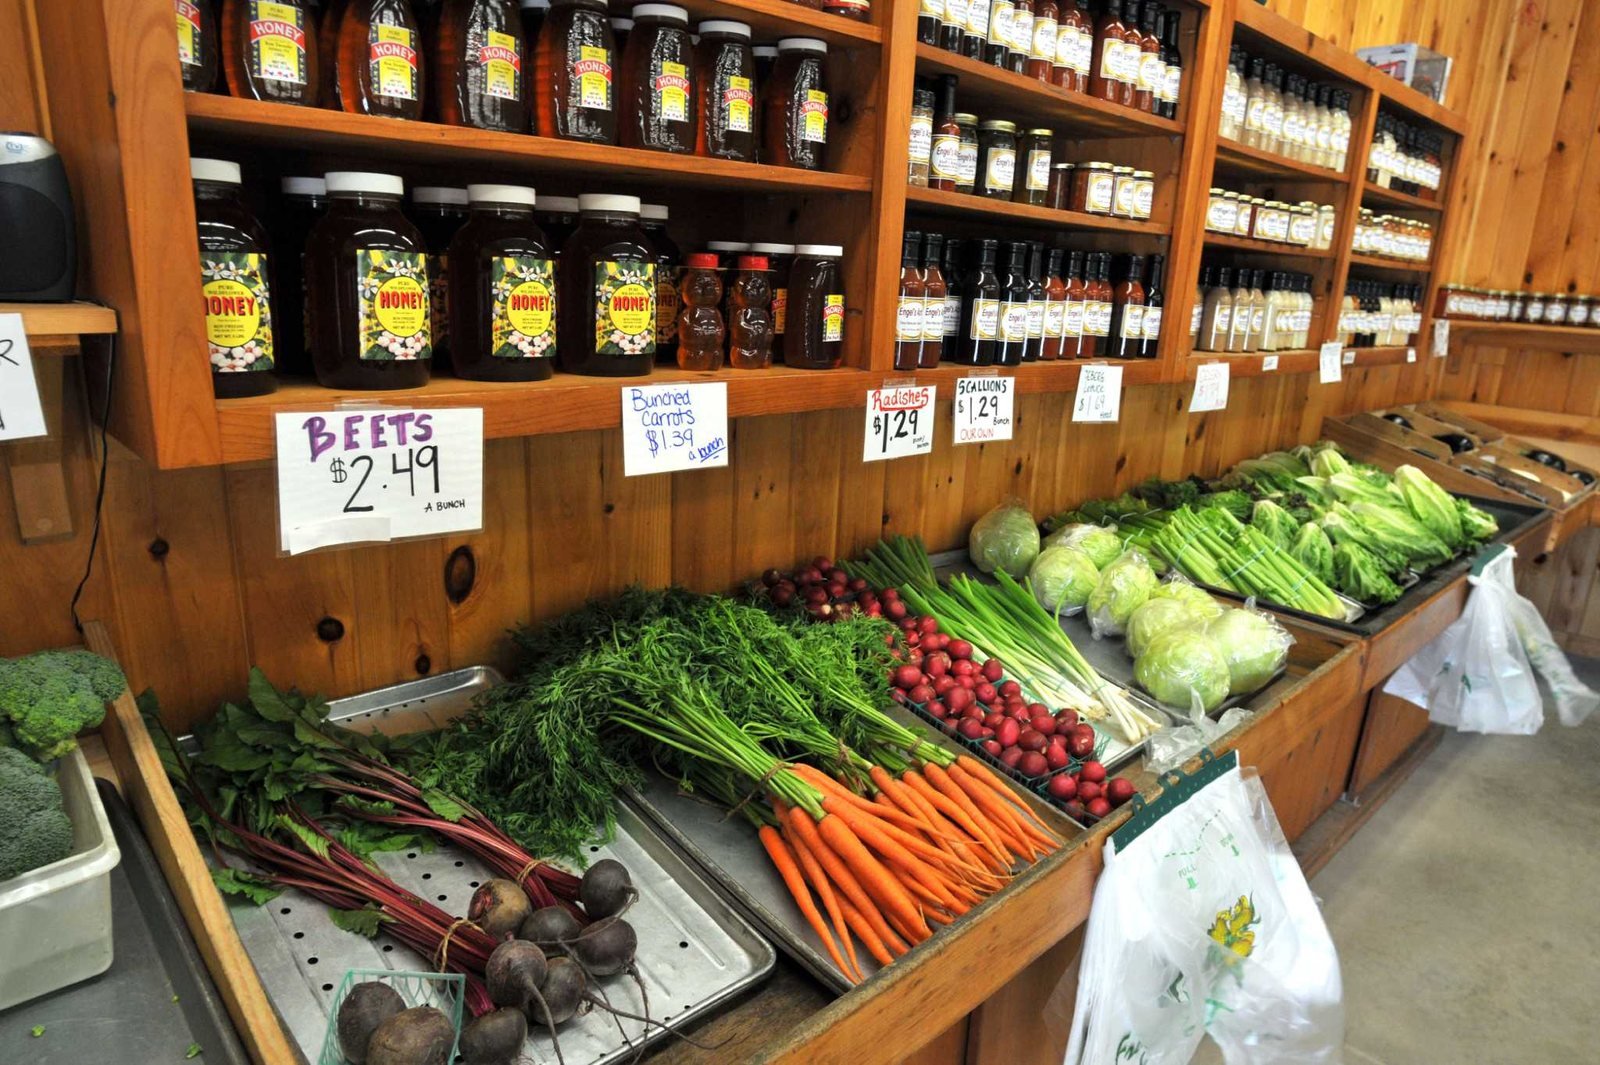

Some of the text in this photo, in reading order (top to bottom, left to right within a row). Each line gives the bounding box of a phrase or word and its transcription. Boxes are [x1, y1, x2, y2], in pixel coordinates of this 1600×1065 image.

[254, 21, 301, 40] HONEY
[375, 43, 414, 60] HONEY
[484, 46, 518, 64] HONEY
[579, 61, 611, 75] HONEY
[659, 76, 690, 90] HONEY
[727, 89, 753, 101] HONEY
[804, 101, 827, 113] HONEY
[379, 290, 423, 310] HONEY
[511, 294, 551, 311] HONEY
[613, 295, 650, 311] HONEY
[958, 379, 1008, 395] SCALLIONS
[631, 388, 692, 412] Bunched
[993, 417, 1010, 426] Bunch
[302, 412, 433, 463] BEETS
[873, 409, 919, 453] $1.29
[960, 428, 995, 441] OUR OWN
[645, 428, 694, 459] $1.39
[688, 437, 725, 461] a bunch
[329, 445, 440, 514] $2.49
[424, 499, 466, 513] A BUNCH
